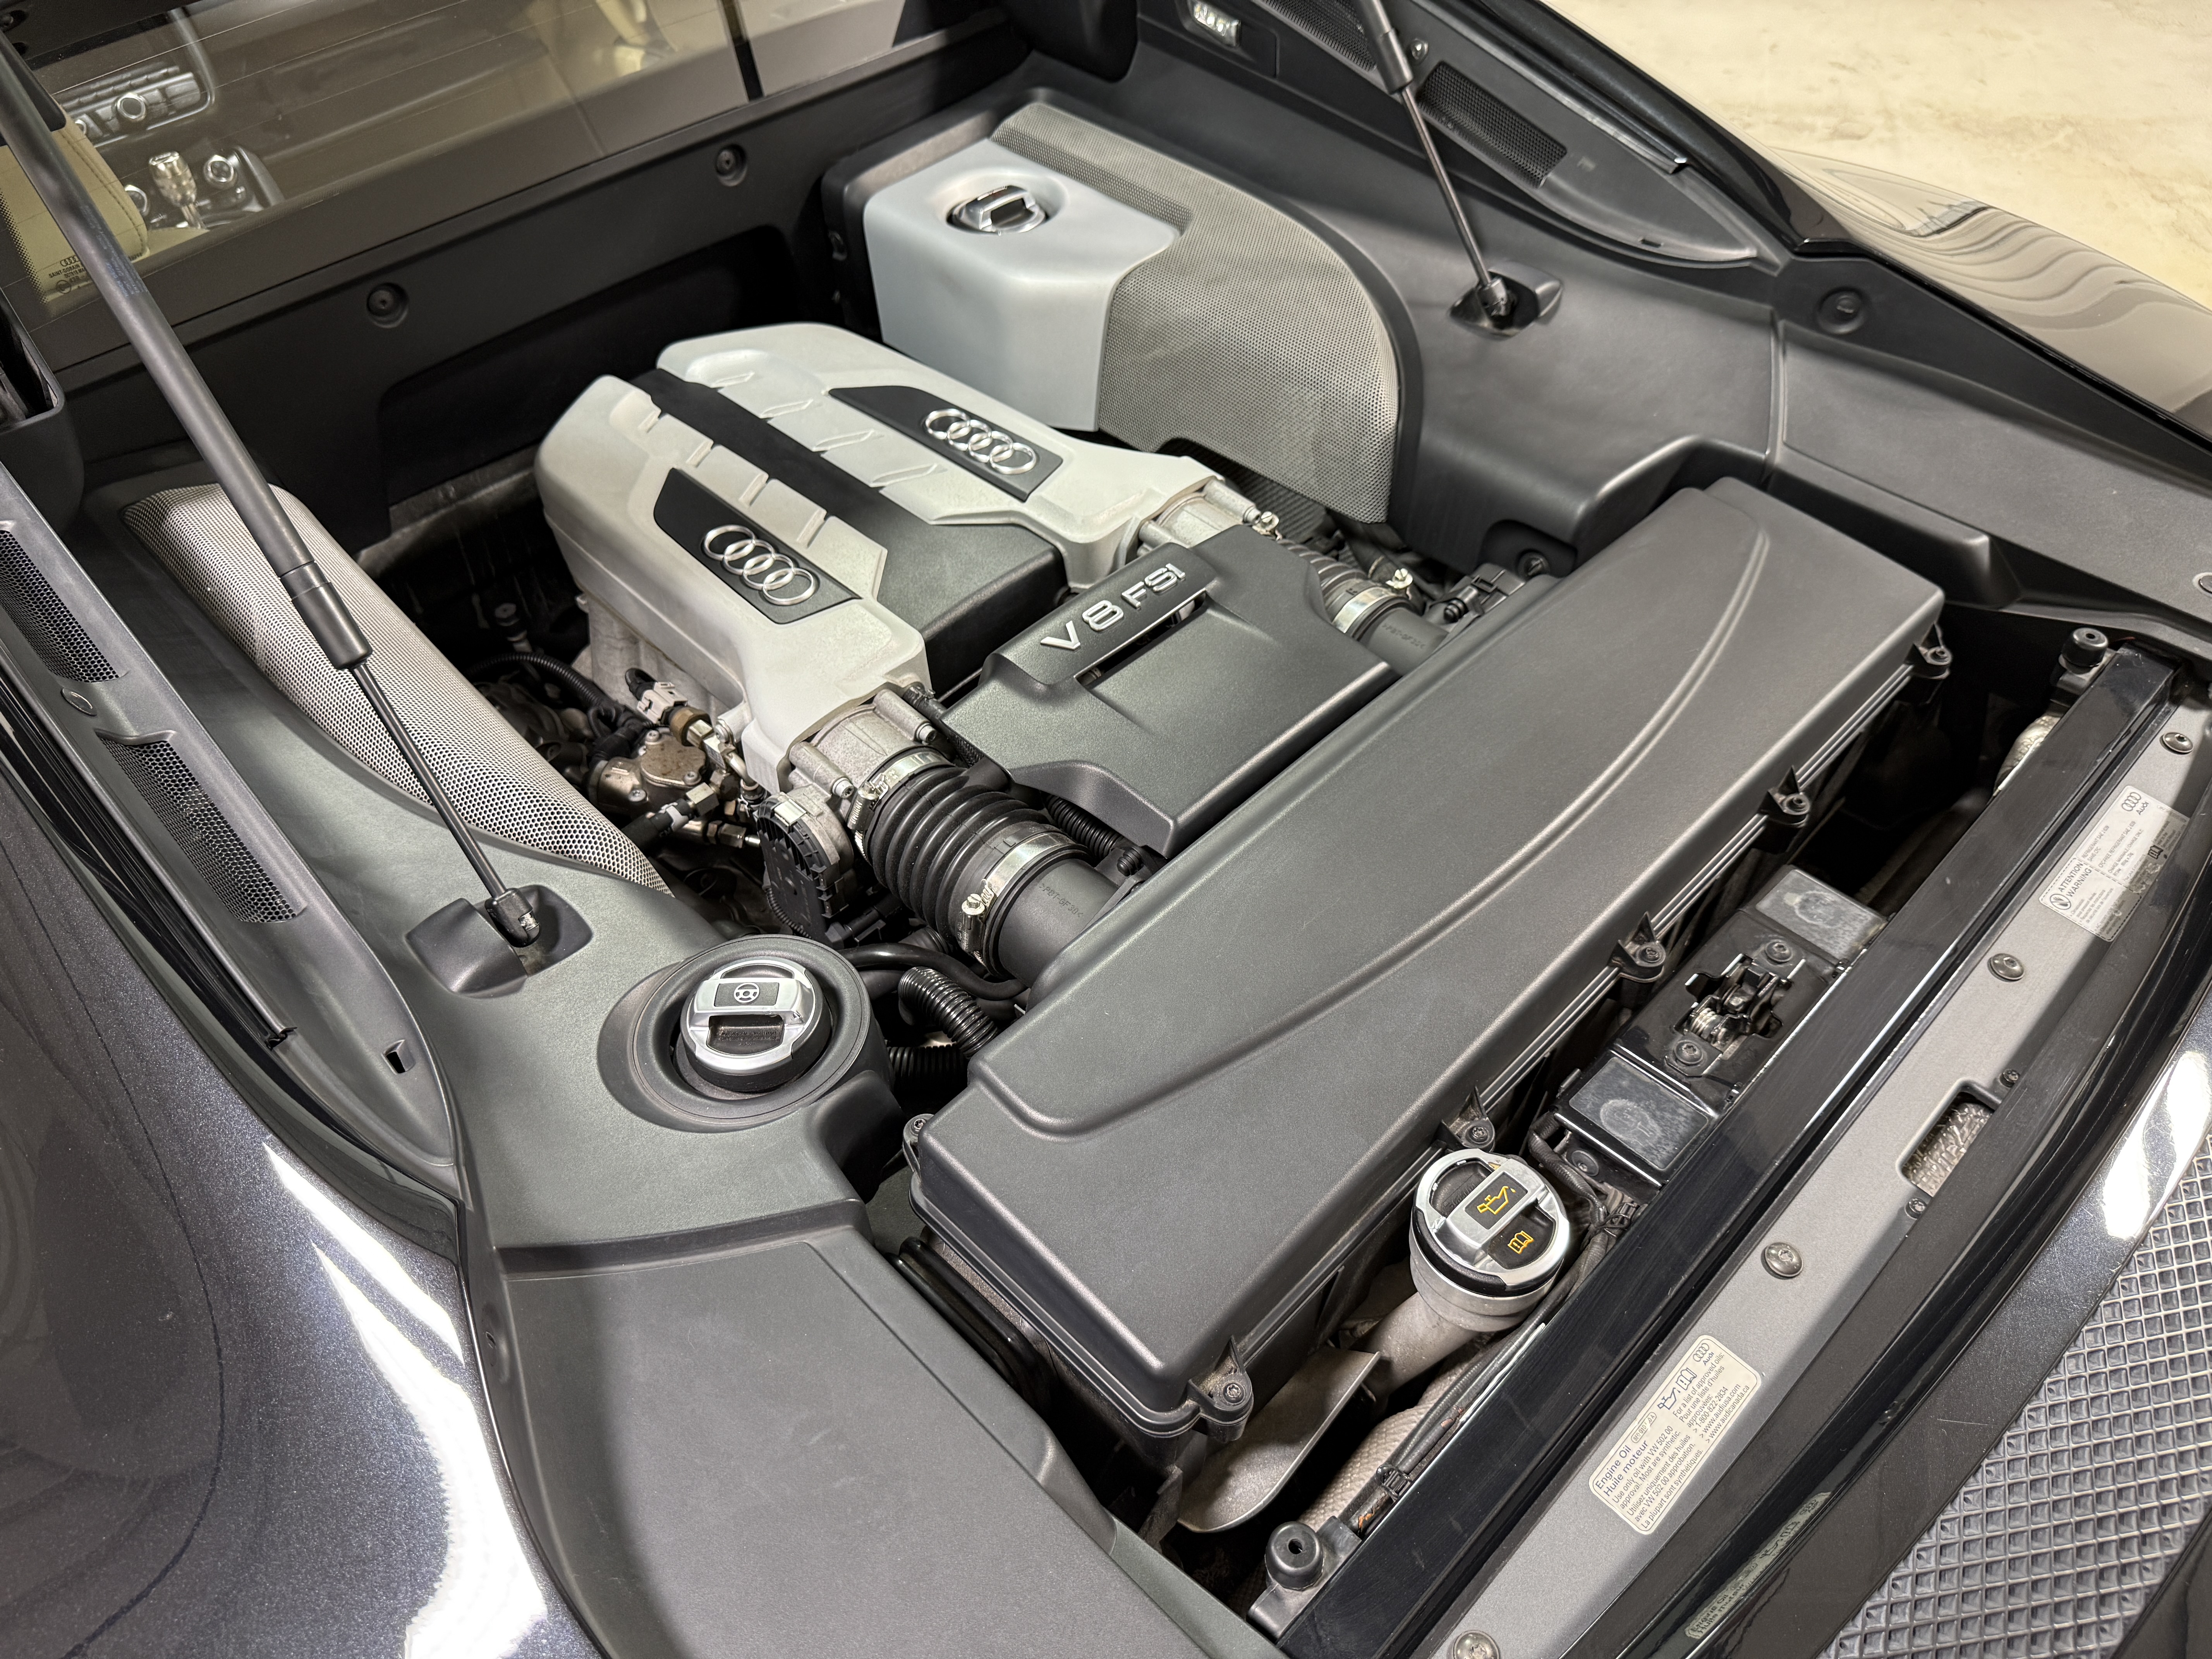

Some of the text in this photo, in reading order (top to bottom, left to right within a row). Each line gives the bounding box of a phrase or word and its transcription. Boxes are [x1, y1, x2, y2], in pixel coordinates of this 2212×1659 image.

[1040, 563, 1186, 650] V8 FSI
[2135, 800, 2150, 816] Audi
[2057, 861, 2084, 893] ATTENTION
[2065, 867, 2092, 897] WARNING
[1672, 1406, 1683, 1419] For
[1683, 1394, 1693, 1404] list
[1691, 1386, 1698, 1395] of
[1695, 1362, 1717, 1389] approved
[1714, 1352, 1724, 1364] oils:
[1702, 1352, 1714, 1366] Audi
[1679, 1365, 1725, 1423] Pour une liste d'huiles
[1686, 1394, 1713, 1428] approuvées:
[1695, 1386, 1728, 1427] 1-800-822-2834
[1702, 1384, 1741, 1433] www.audiusa.com
[1708, 1385, 1750, 1438] www.audicanada.ca
[1595, 1445, 1632, 1490] Engine Oil
[1603, 1440, 1648, 1497] Huile moteur
[1612, 1425, 1673, 1503] Use only oil with VW 502 00
[1620, 1431, 1681, 1509] approval. Most are synthetic.
[1627, 1434, 1691, 1516] Utilisez uniquement des huiles
[1635, 1444, 1696, 1522] avec VW 502 00 approbation.
[1641, 1449, 1704, 1530] La plupart sont synthétiques.
